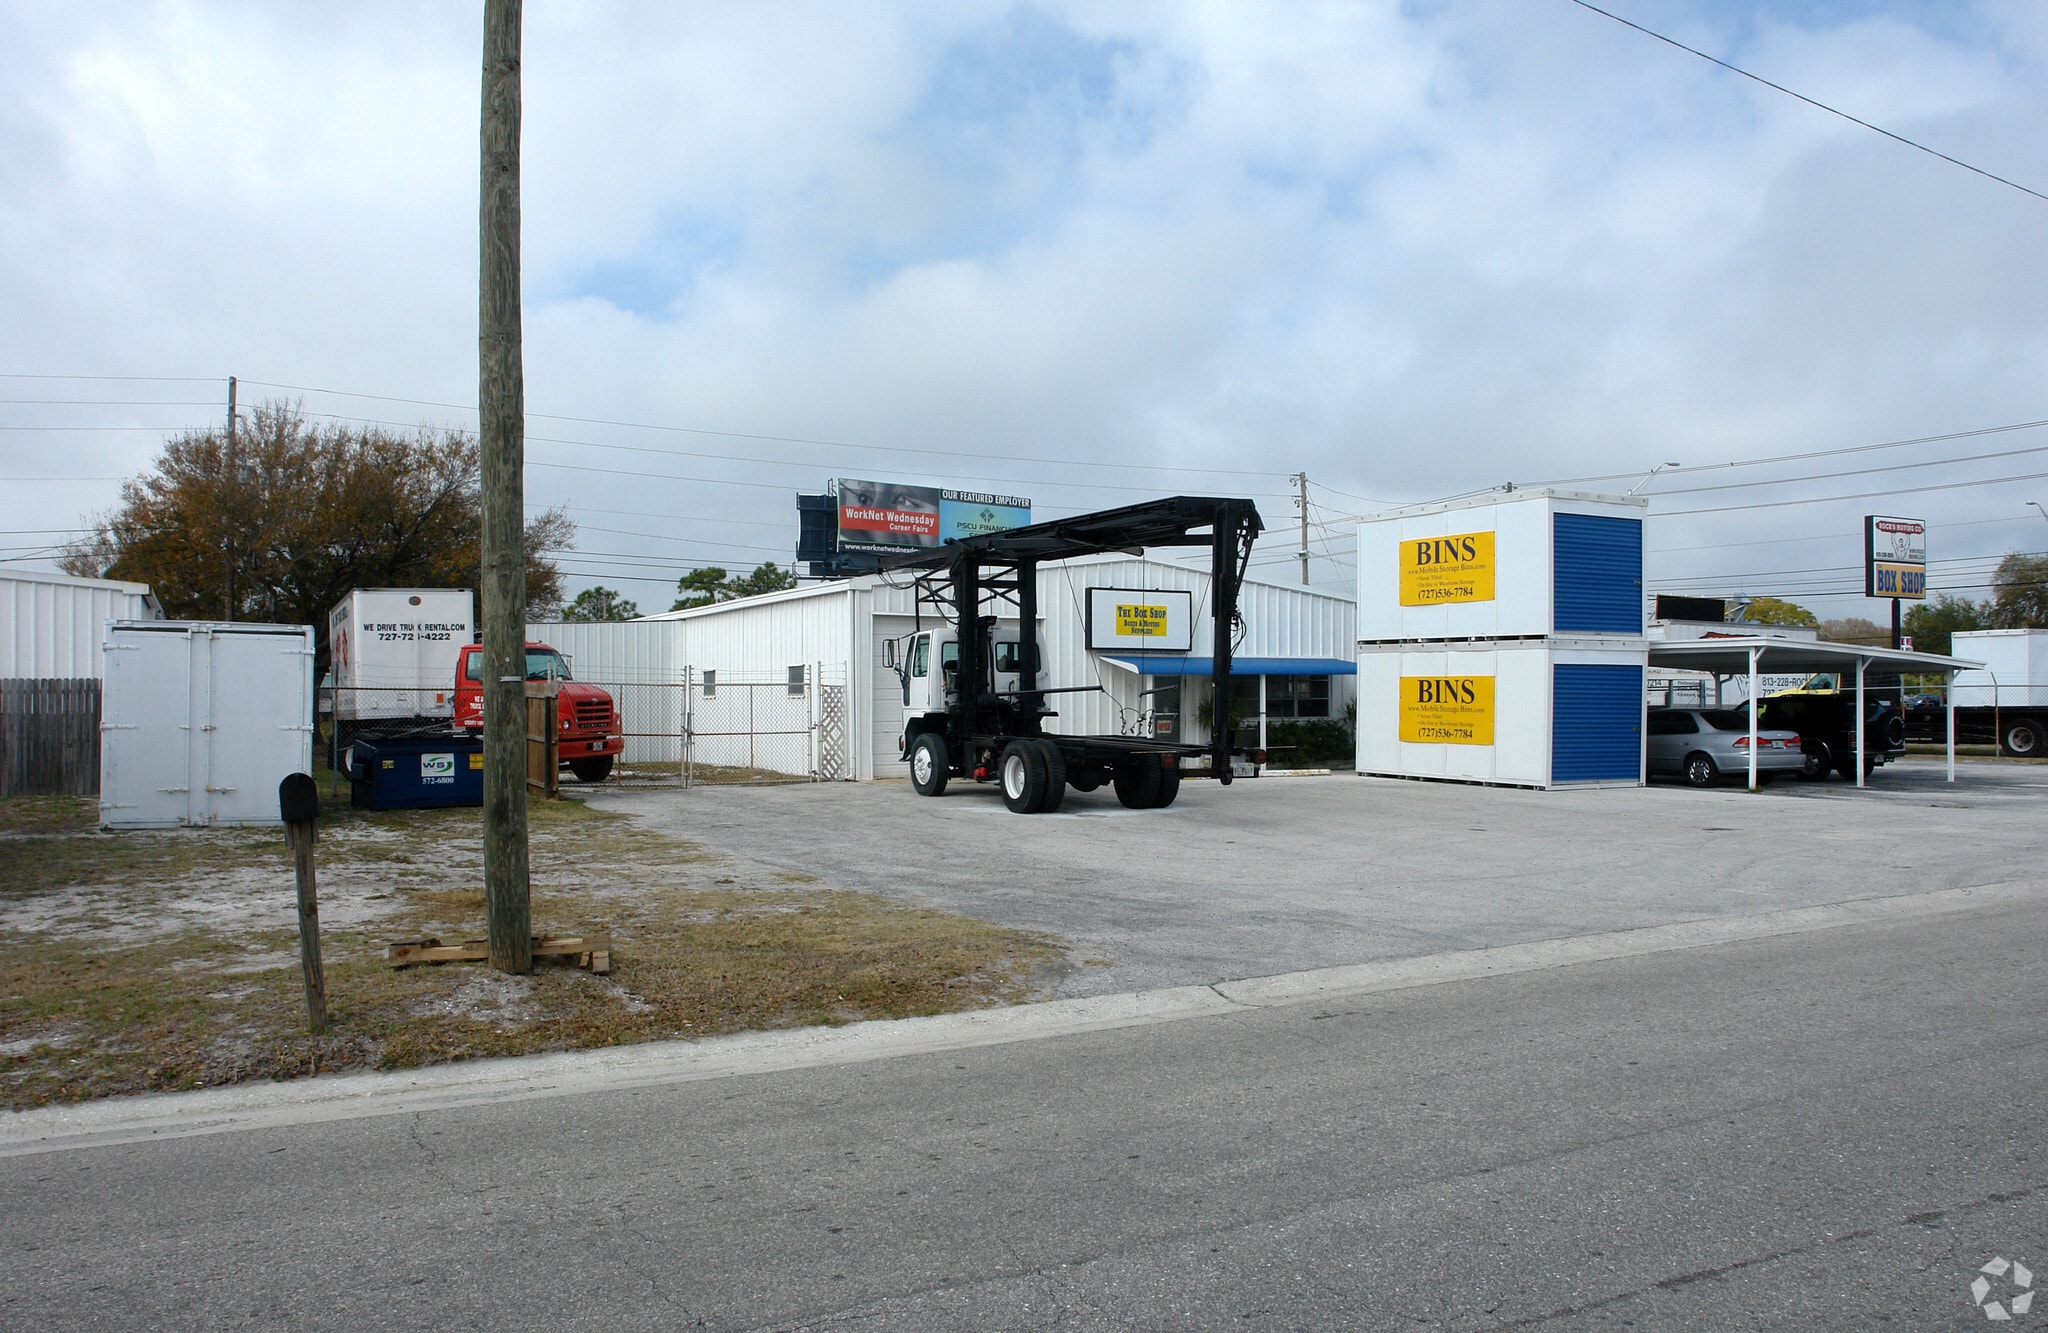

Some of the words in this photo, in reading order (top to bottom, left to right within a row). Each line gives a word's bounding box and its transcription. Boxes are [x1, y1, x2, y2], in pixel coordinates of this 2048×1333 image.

[942, 490, 958, 499] OUR
[960, 492, 993, 503] FEATURED
[996, 496, 1029, 507] EMPLOYER
[846, 508, 884, 520] WorkNet
[887, 512, 935, 526] Wednesday
[890, 523, 911, 531] Career
[913, 525, 928, 533] Fairs
[957, 522, 977, 530] PSCU
[1416, 536, 1476, 566] BINS
[1878, 570, 1897, 592] BOX
[1902, 571, 1926, 594] SHOP
[1418, 587, 1473, 600] (727)536-7784
[1118, 606, 1131, 618] THE
[1134, 607, 1147, 618] BOX
[1150, 608, 1166, 619] SHOP
[1417, 679, 1475, 704] BINS
[1418, 727, 1473, 738] (727)536-7784
